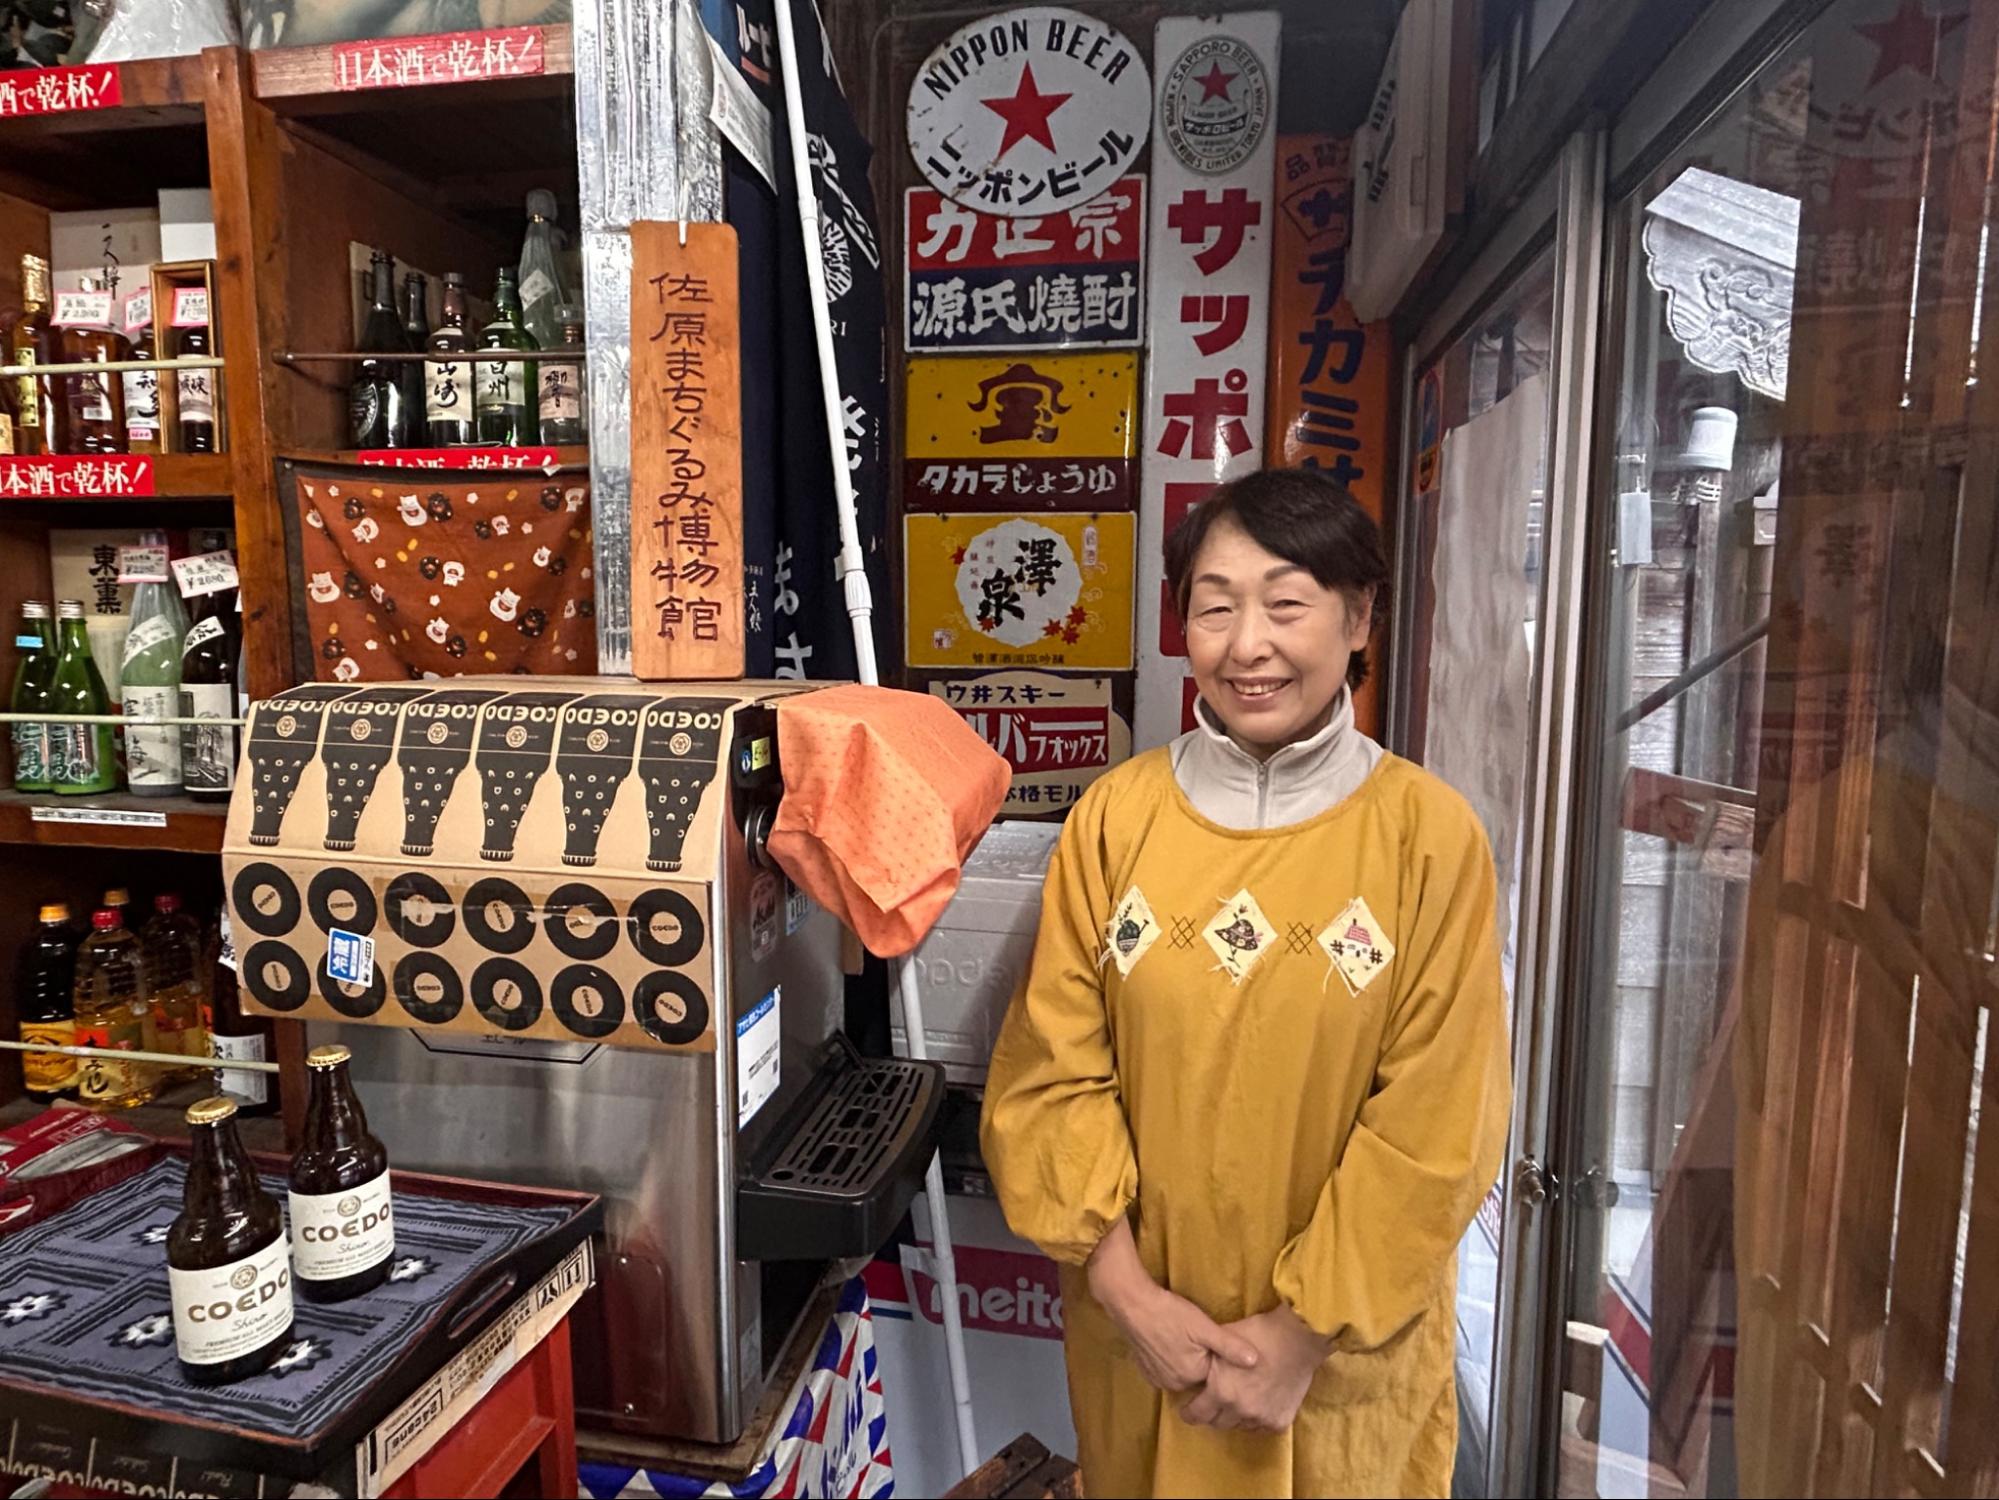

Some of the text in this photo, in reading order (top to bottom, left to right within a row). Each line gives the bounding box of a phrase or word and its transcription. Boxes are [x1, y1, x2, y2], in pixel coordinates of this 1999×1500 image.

[339, 35, 536, 87] 日本酒で乾杯!
[922, 18, 1132, 101] NIPPON BEER
[1173, 41, 1258, 82] SAPPORO BEER
[926, 129, 1134, 206] ニッポンビール
[649, 272, 722, 642] 佐原まちぐるみ博物館
[0, 461, 147, 495] 本酒で乾杯!
[917, 464, 1118, 497] タカラじょうゆ
[408, 703, 478, 720] COEDO
[485, 705, 557, 723] COEDO
[565, 707, 639, 727] COEDO
[647, 710, 723, 731] COEDO
[302, 1202, 390, 1243] COEDO
[188, 1267, 289, 1323] COEDO
